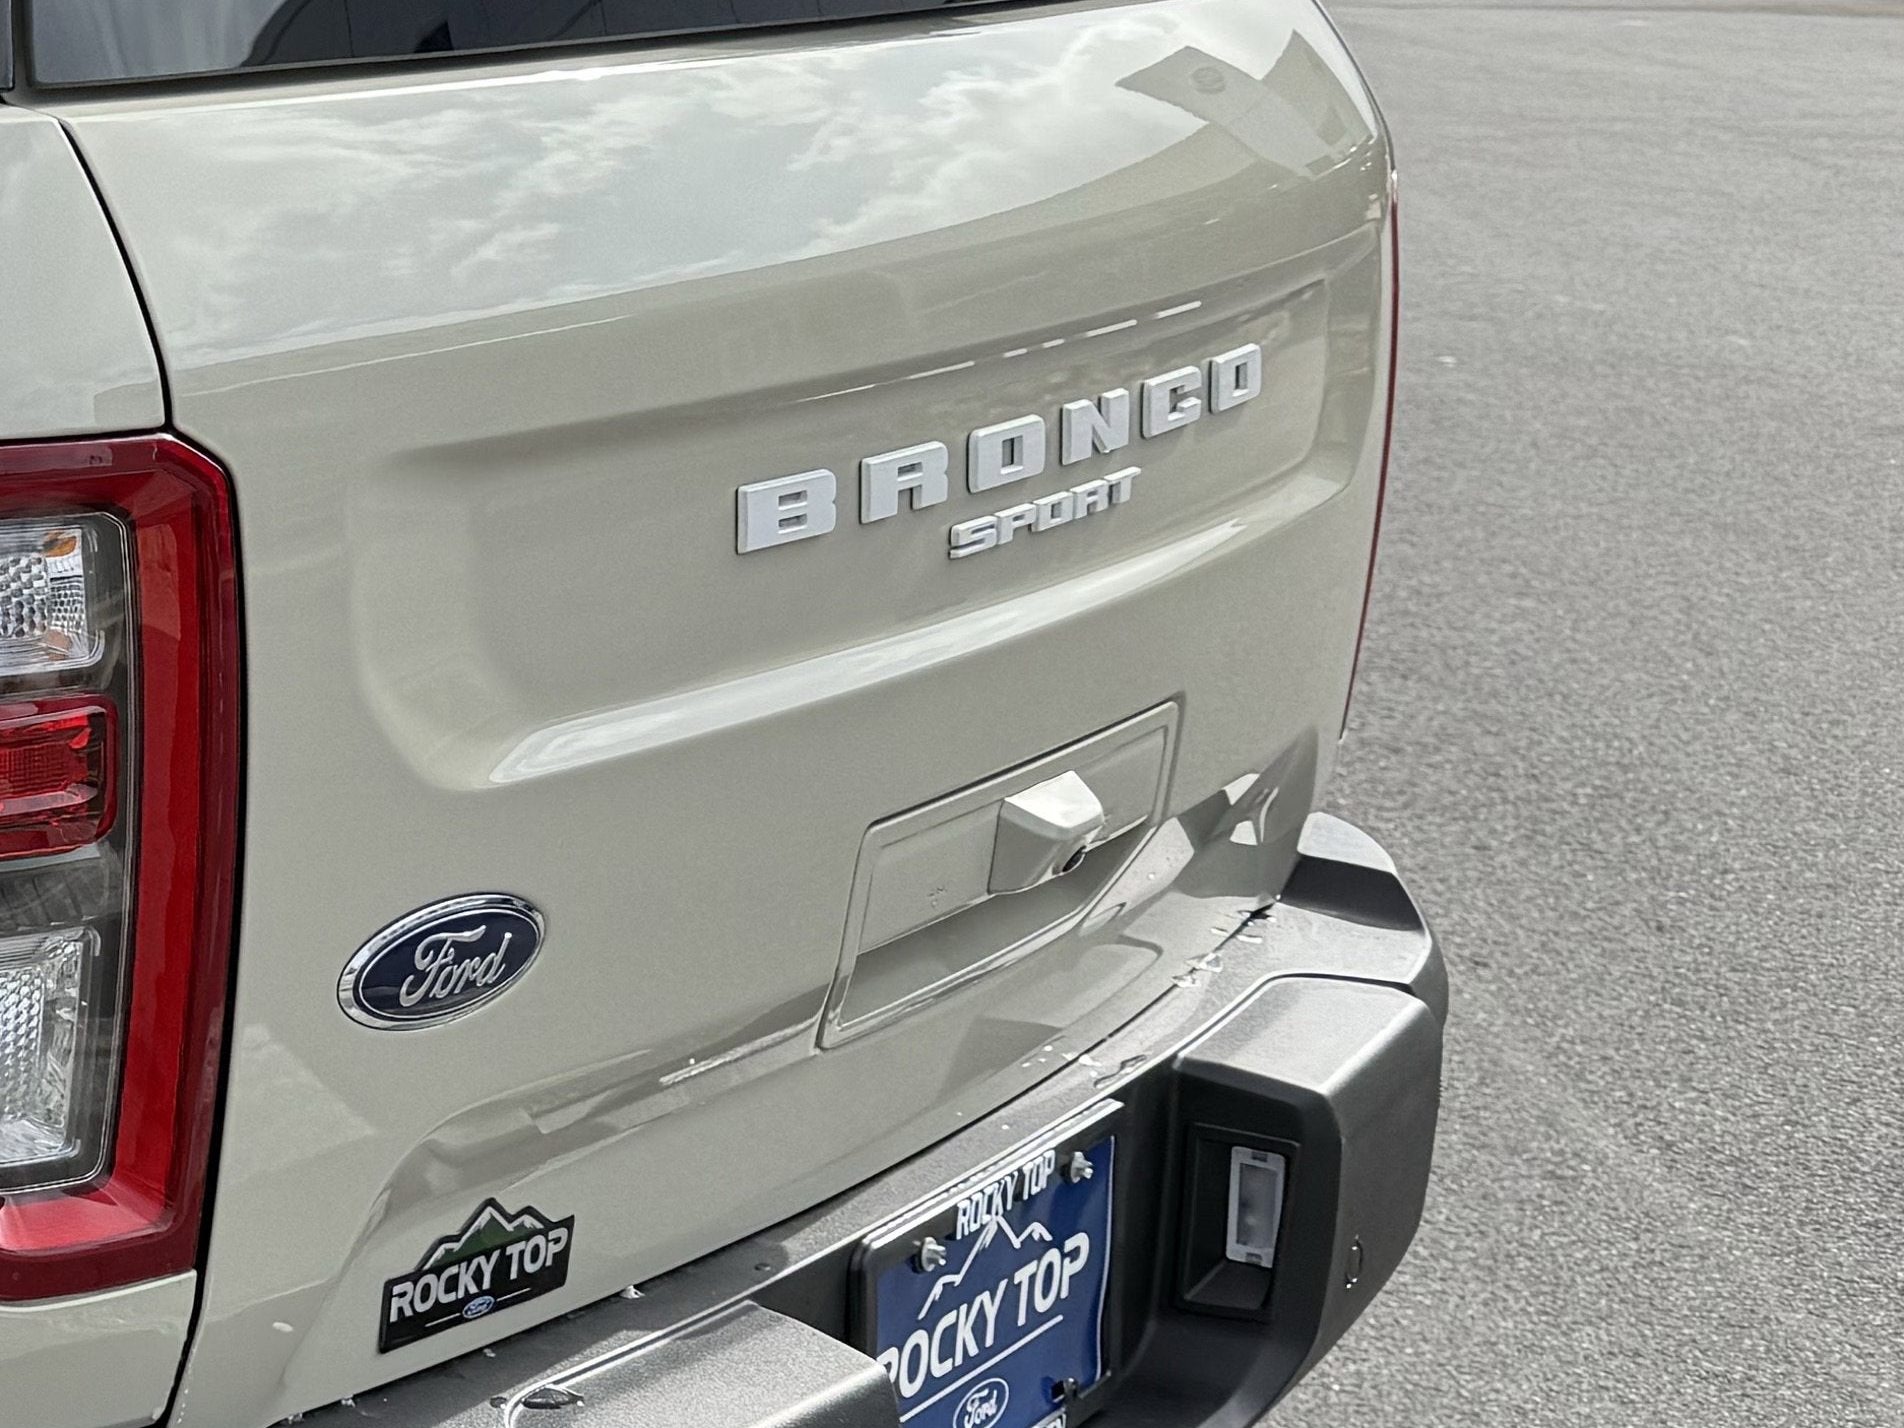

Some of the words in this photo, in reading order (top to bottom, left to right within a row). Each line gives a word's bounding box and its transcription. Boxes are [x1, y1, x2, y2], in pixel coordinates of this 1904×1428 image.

[736, 343, 1262, 554] BRONCO
[949, 466, 1141, 559] SPORT
[399, 924, 513, 1007] Ford
[956, 1171, 1019, 1240] ROCKY
[1022, 1150, 1055, 1200] TOP
[390, 1249, 500, 1322] ROCKY
[506, 1227, 569, 1280] TOP
[1014, 1232, 1090, 1326] TOP
